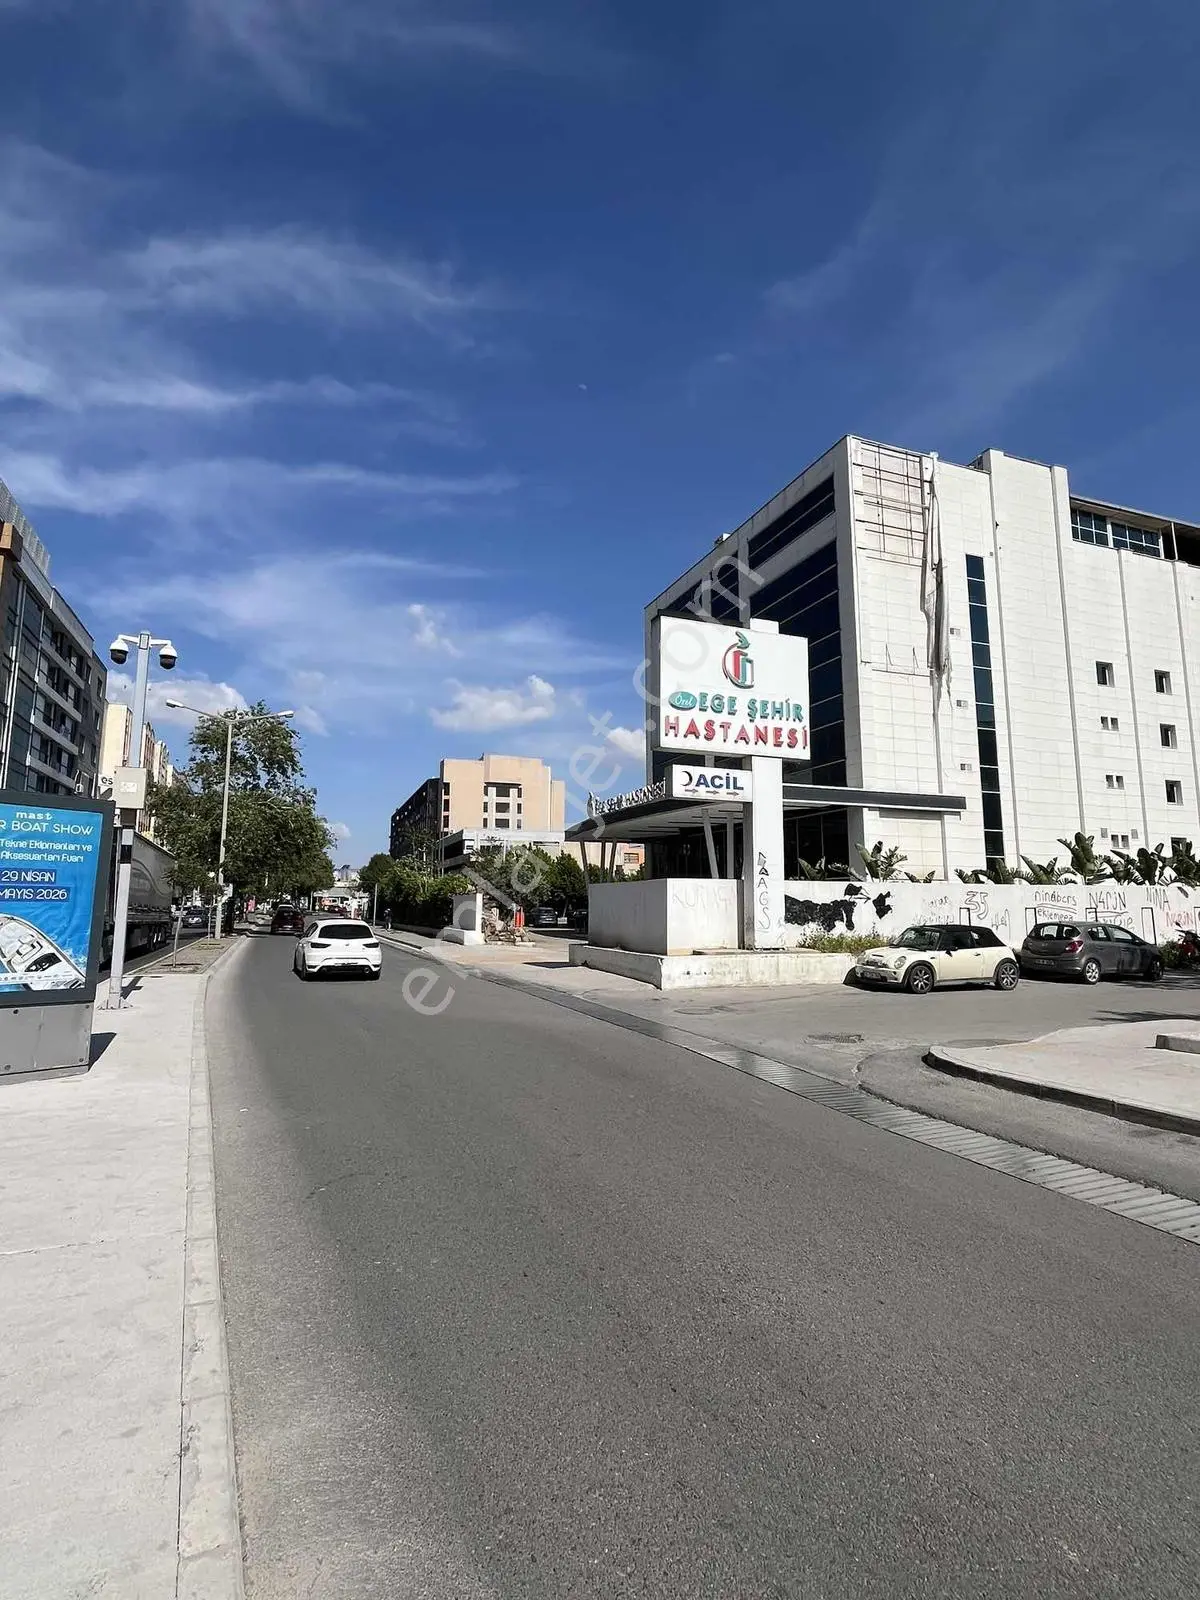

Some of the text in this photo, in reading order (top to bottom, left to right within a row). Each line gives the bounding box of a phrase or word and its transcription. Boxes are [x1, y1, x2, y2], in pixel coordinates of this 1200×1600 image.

[698, 692, 738, 716] EGE
[747, 697, 804, 722] ŞEHİR
[664, 715, 809, 750] HASTANESİ
[695, 772, 744, 791] ACİL
[16, 811, 52, 821] mast
[11, 820, 49, 832] BOAT
[53, 823, 94, 836] SHOW
[0, 839, 27, 849] Tekne
[1, 870, 56, 882] 29 NİSAN
[36, 888, 68, 900] 2026
